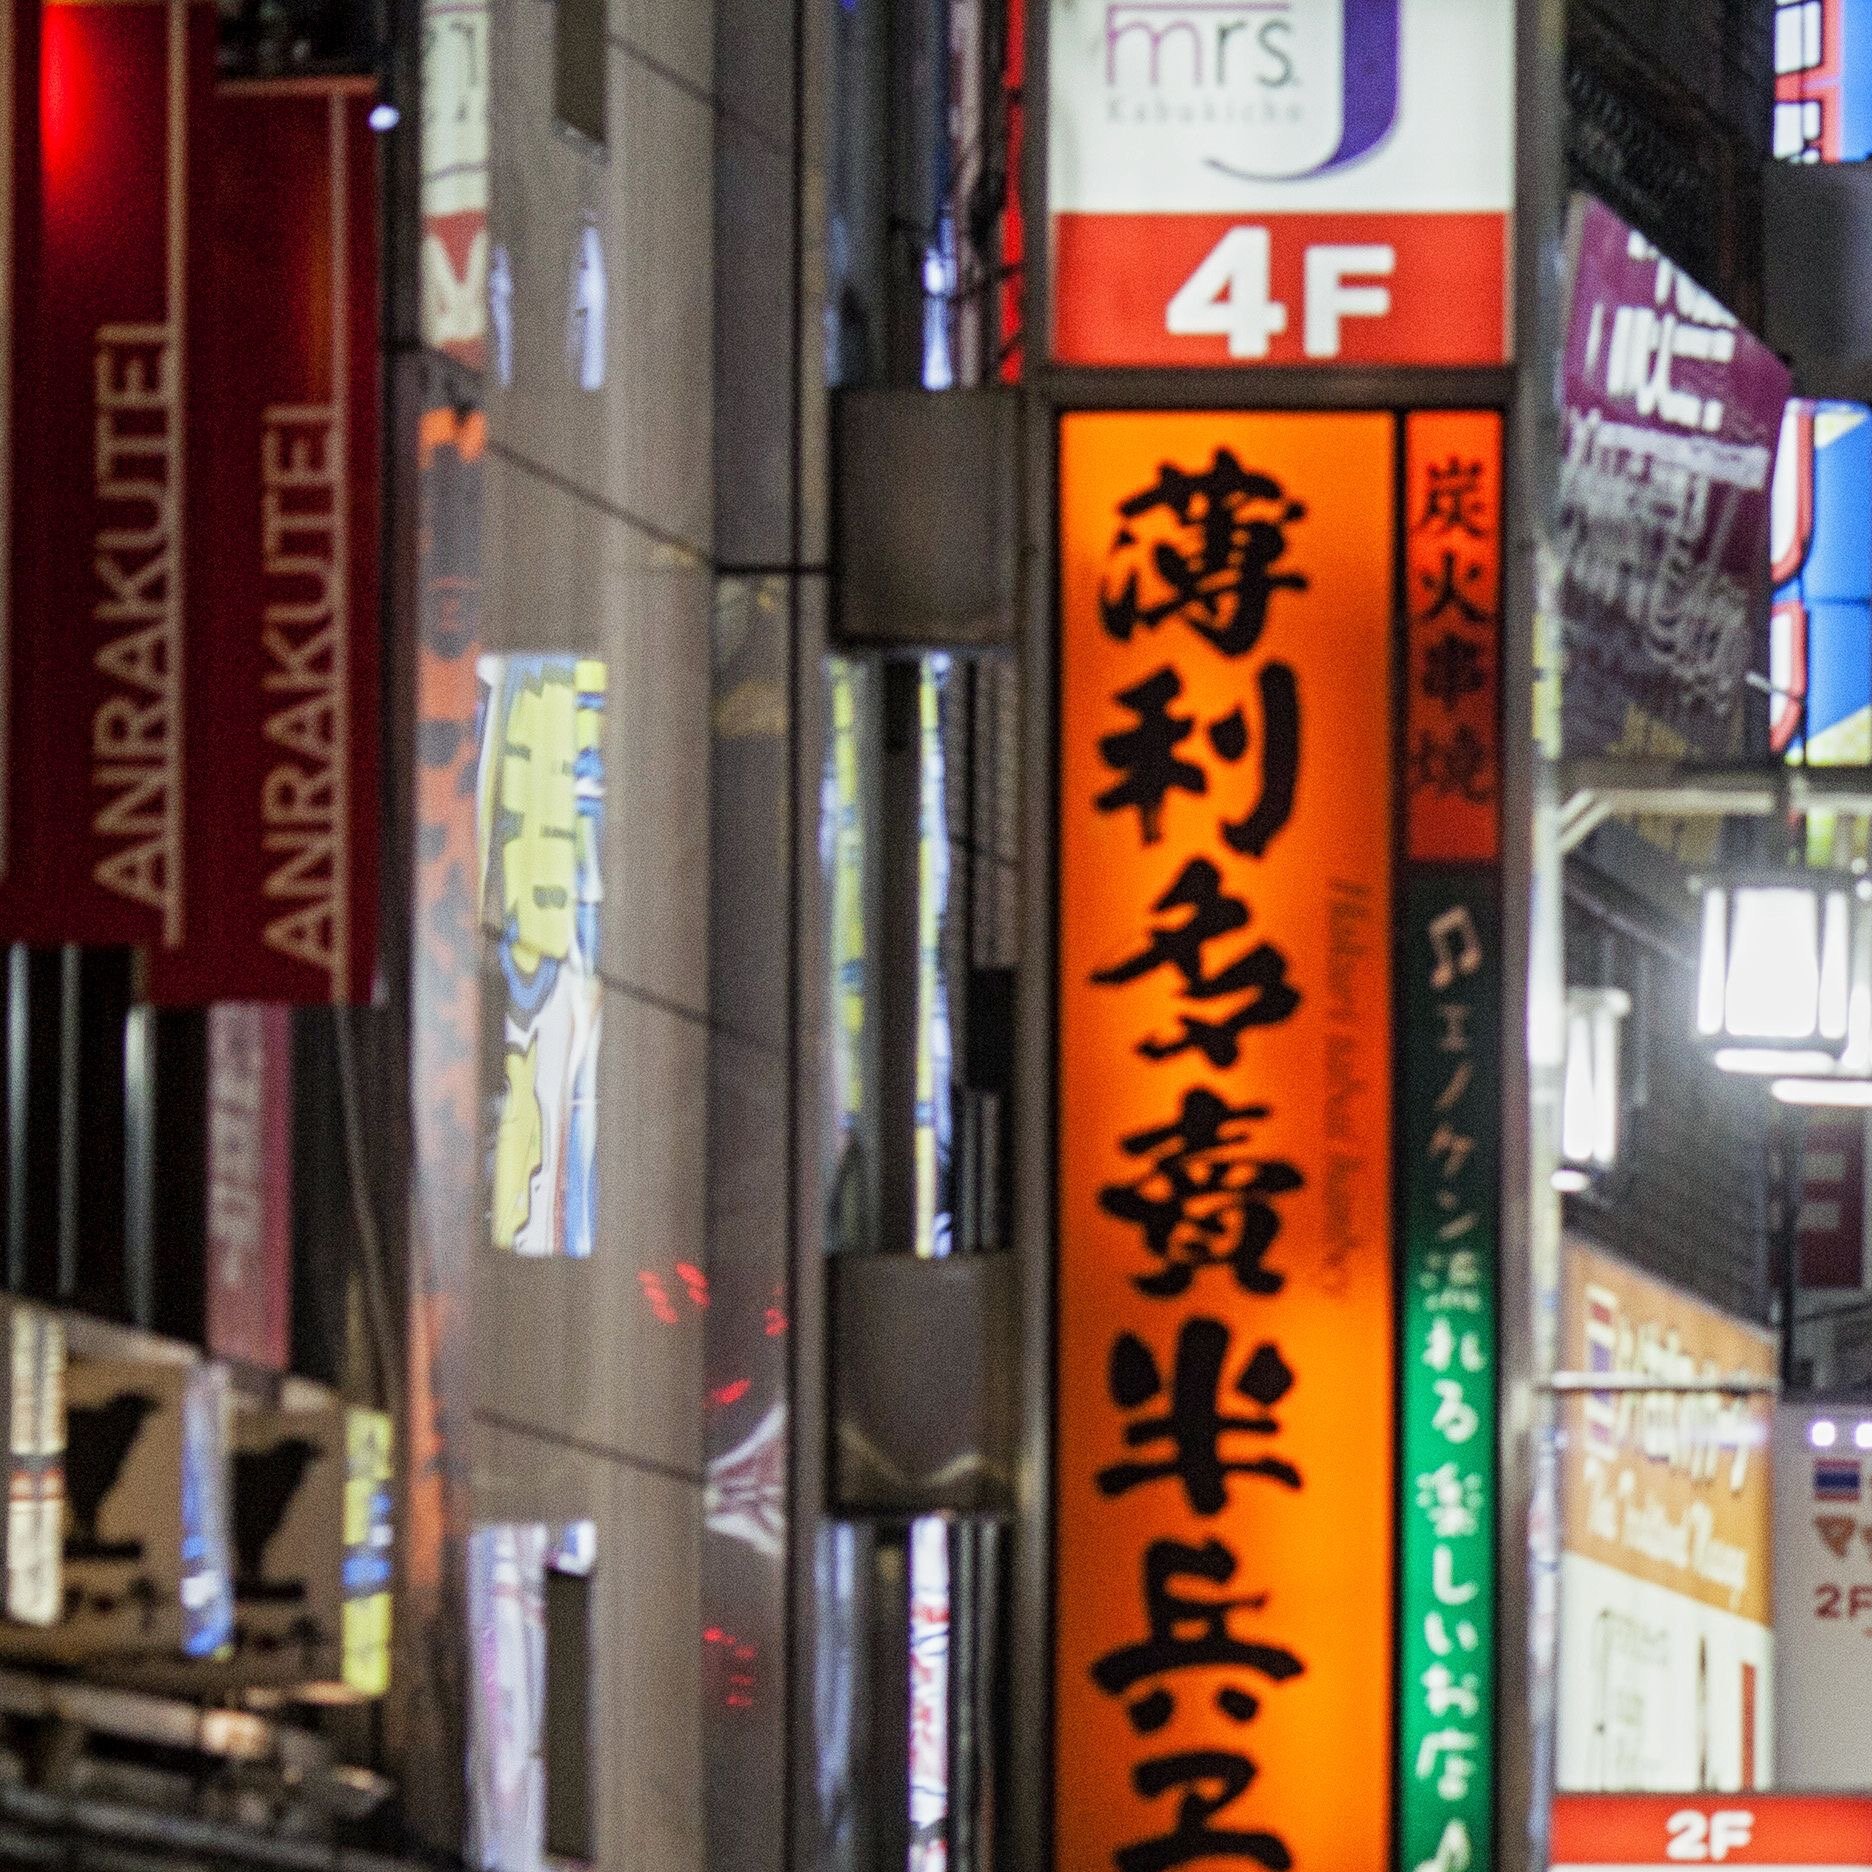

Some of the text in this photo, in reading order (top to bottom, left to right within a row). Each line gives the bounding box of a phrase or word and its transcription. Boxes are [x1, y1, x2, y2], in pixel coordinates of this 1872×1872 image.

[1165, 225, 1396, 360] 4F
[94, 323, 168, 913] ANRAKUTEI
[263, 404, 334, 971] ANRAKUTEI
[1665, 1810, 1754, 1862] 2F
